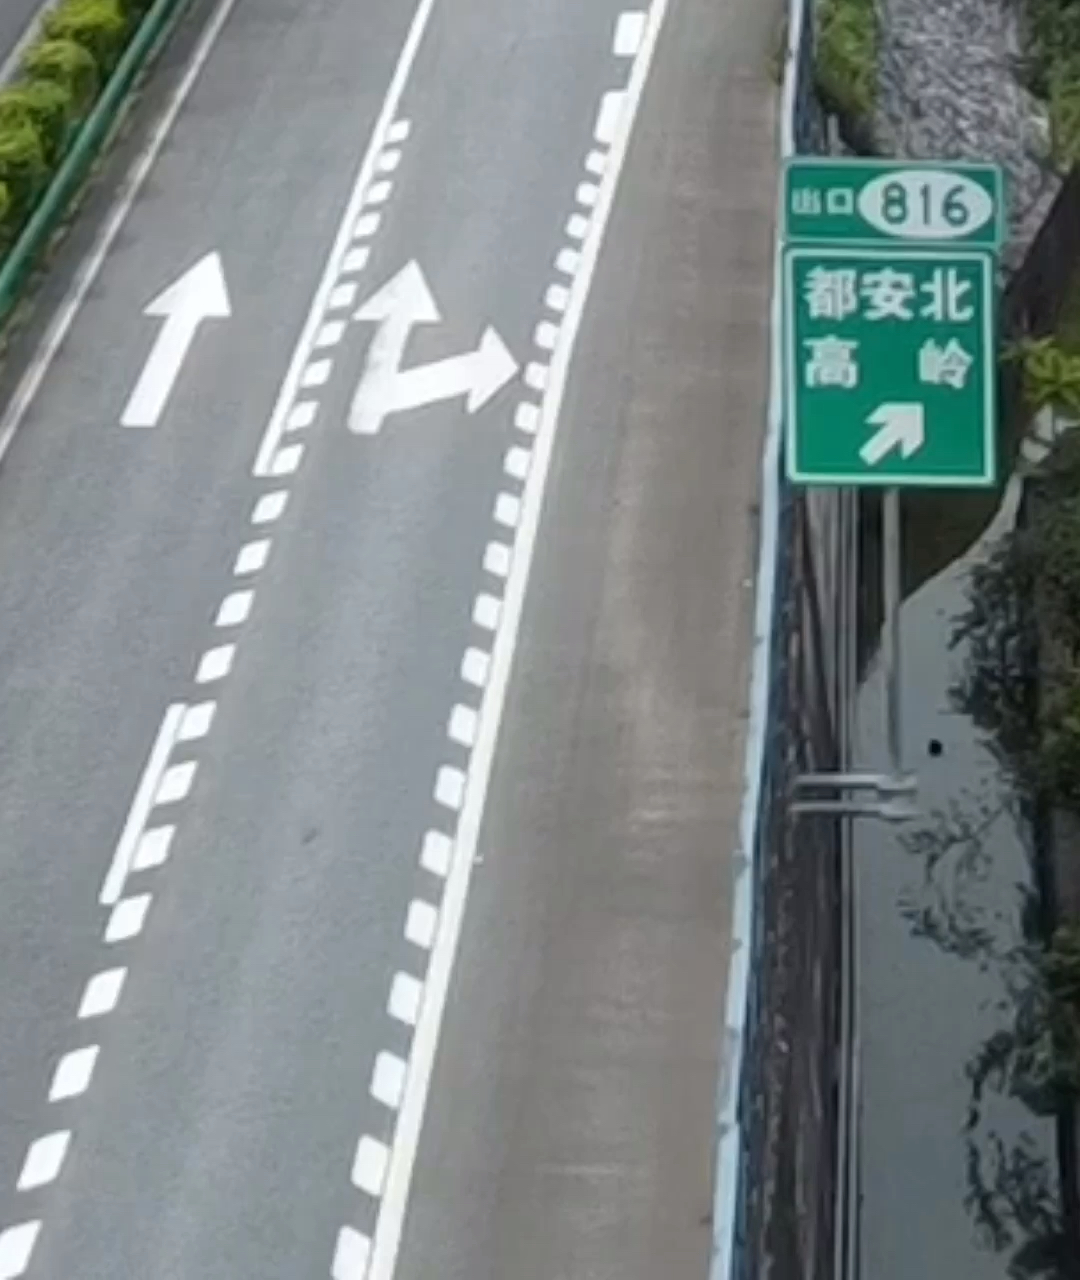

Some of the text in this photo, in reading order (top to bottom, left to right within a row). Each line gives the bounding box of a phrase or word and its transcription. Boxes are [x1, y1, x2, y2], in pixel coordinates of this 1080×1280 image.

[792, 181, 968, 227] 出口 816
[803, 265, 974, 321] 都安北
